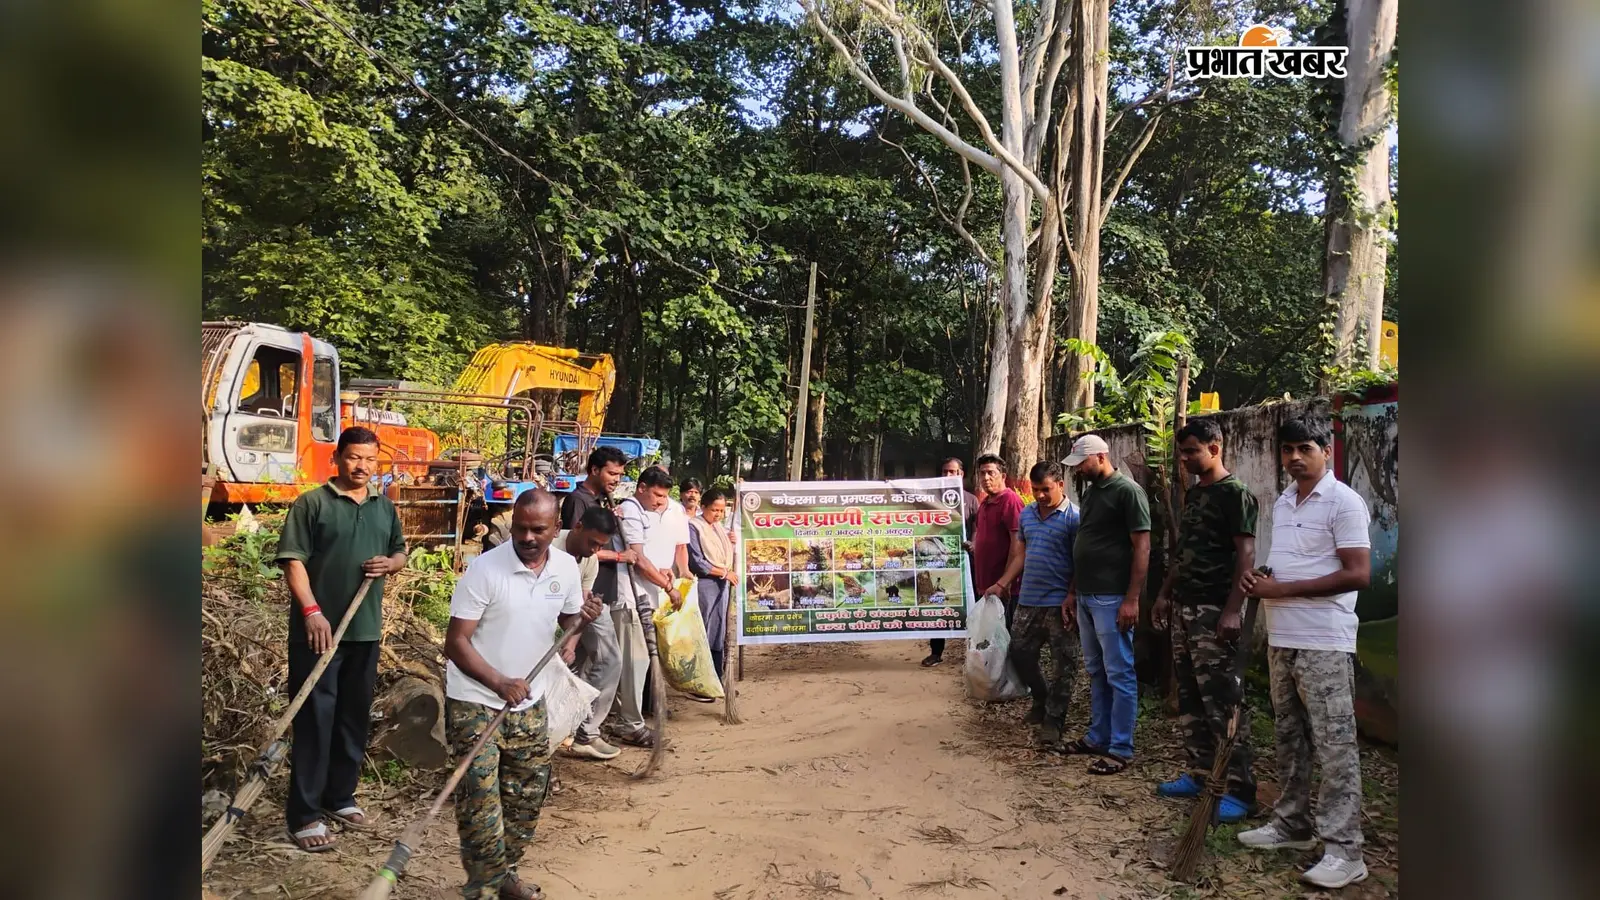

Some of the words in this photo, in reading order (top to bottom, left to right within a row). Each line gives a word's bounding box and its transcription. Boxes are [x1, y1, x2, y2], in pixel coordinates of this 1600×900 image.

[549, 369, 580, 385] HYUNDAI
[771, 493, 816, 506] कोडरमा
[818, 495, 837, 504] वन
[891, 491, 935, 504] कोडरमा
[868, 509, 952, 526] सप्ताह
[749, 613, 773, 621] कोडरमा
[782, 624, 806, 632] कोडरमा
